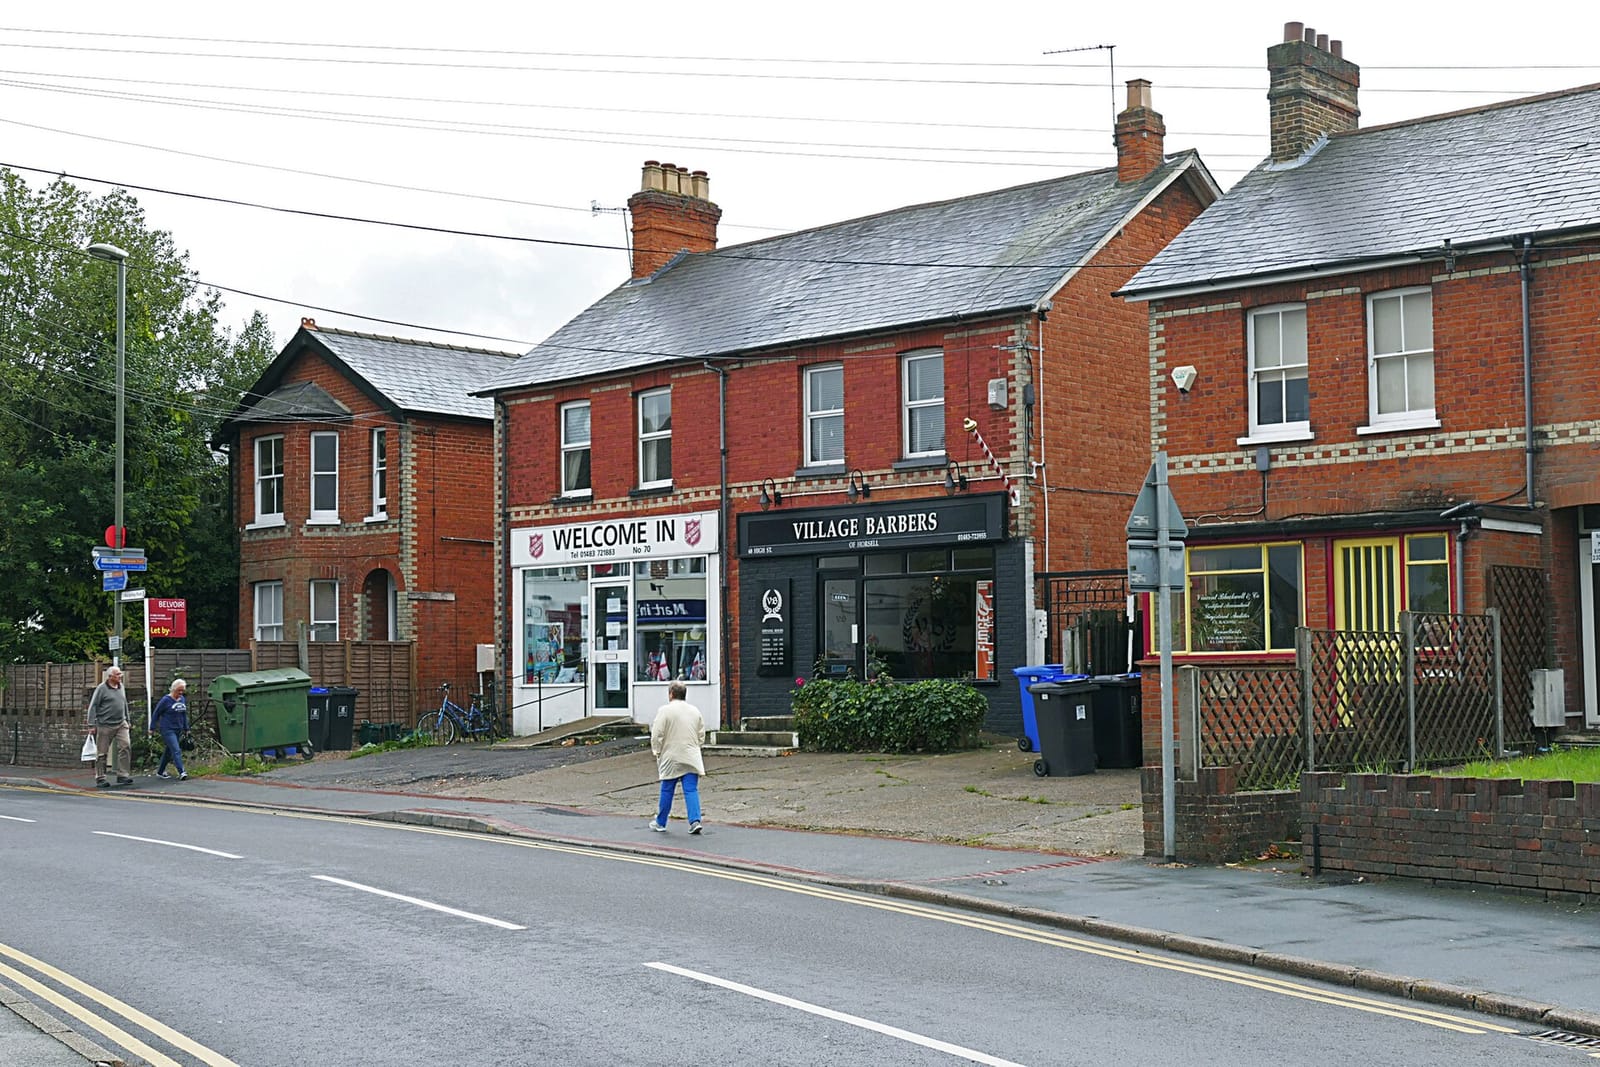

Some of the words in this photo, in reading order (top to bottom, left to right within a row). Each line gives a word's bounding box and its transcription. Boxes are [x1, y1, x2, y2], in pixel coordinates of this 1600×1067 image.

[792, 518, 859, 540] VILLAGE
[866, 512, 938, 535] BARBERS
[553, 522, 647, 550] WELCOME
[656, 519, 675, 542] IN
[633, 546, 642, 554] No
[644, 545, 652, 553] 70
[571, 551, 579, 559] Tel
[161, 626, 170, 636] by
